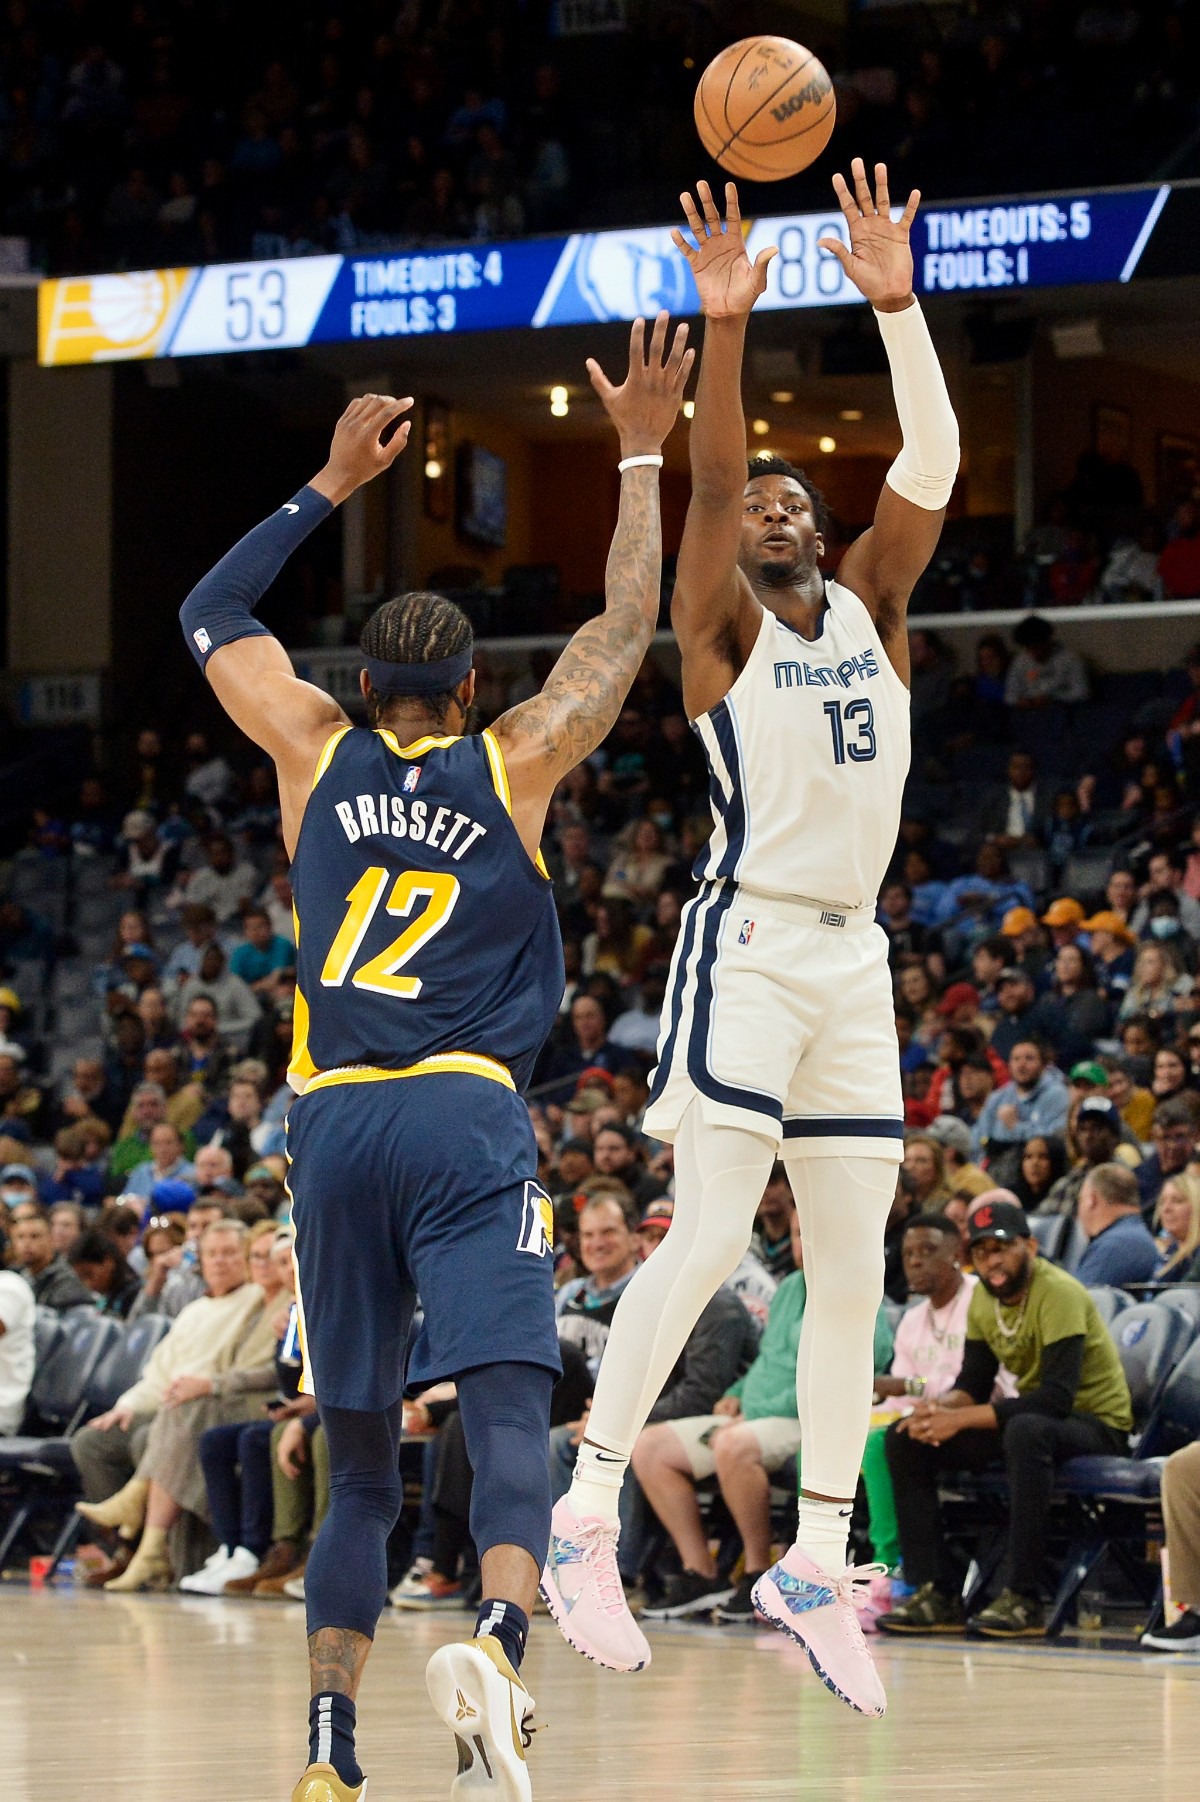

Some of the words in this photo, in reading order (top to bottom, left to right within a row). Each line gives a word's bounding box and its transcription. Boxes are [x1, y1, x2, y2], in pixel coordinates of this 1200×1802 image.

[924, 203, 1067, 250] TIMEOUTS:
[1070, 201, 1091, 239] 5
[352, 252, 482, 297] TIMEOUTS:
[484, 250, 503, 286] 4
[779, 222, 843, 297] 88
[924, 248, 1014, 291] FOULS:
[226, 269, 286, 341] 53
[351, 296, 434, 336] FOULS:
[436, 294, 456, 331] 3
[774, 648, 879, 688] MEMPHS
[823, 698, 877, 765] 13
[335, 794, 487, 861] BRISSETT
[320, 866, 461, 999] 12
